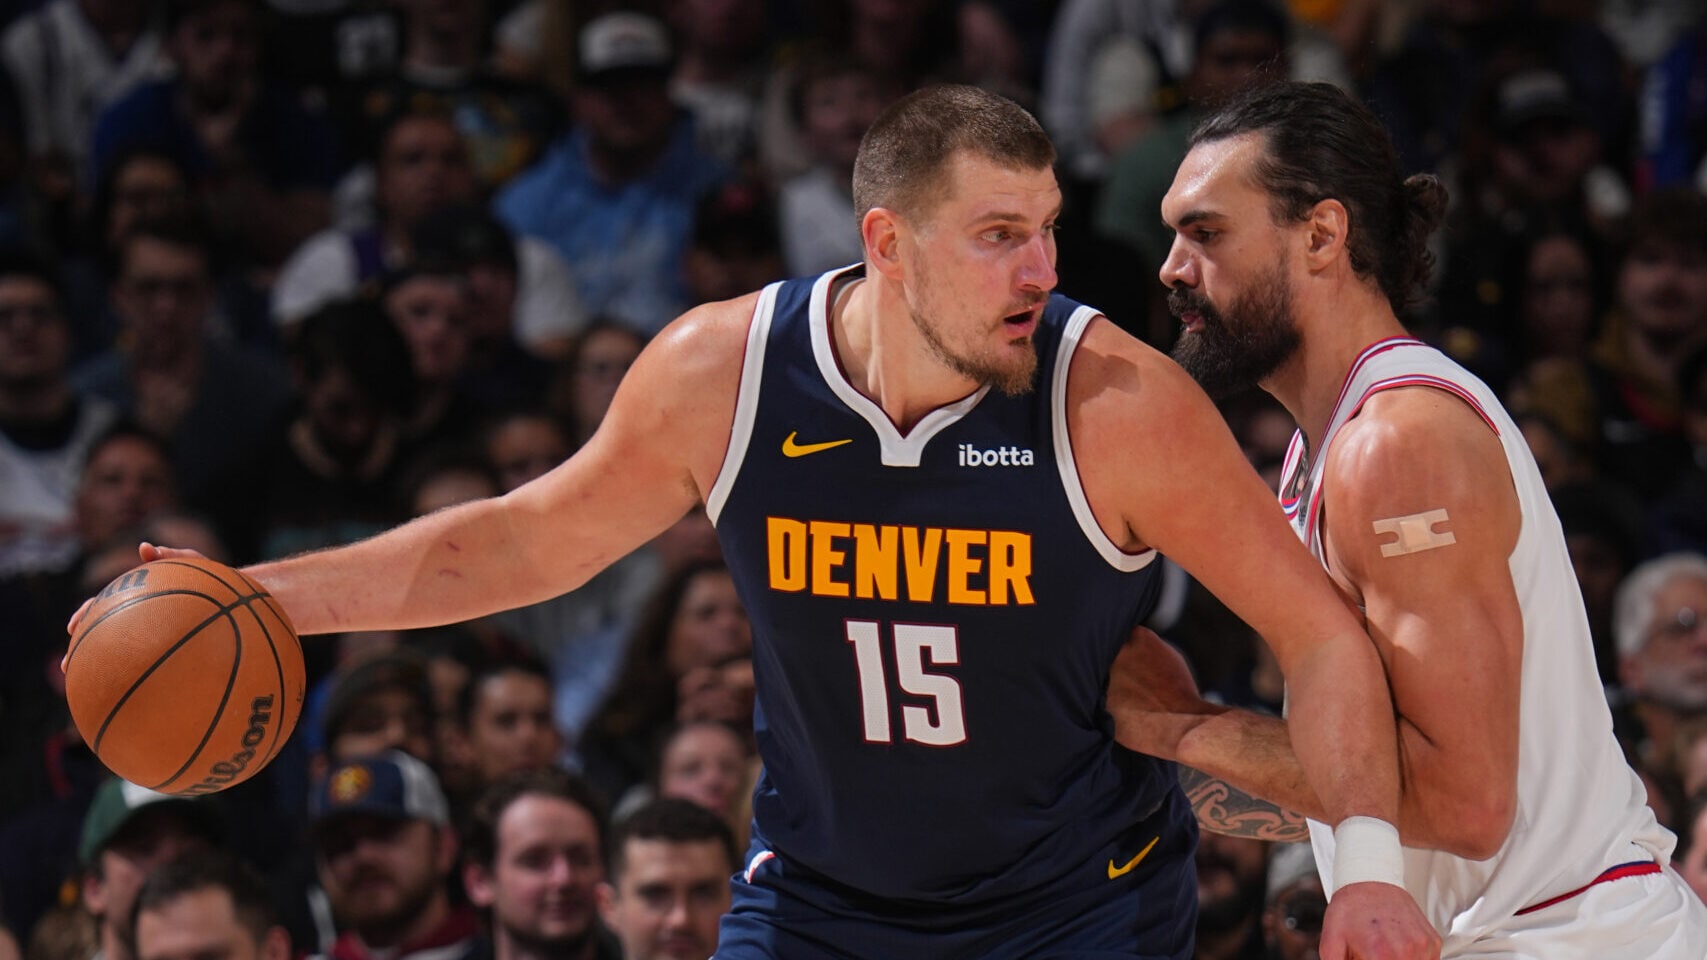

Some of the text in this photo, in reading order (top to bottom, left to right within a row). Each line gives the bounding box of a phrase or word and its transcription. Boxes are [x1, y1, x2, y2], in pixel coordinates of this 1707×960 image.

[958, 444, 1035, 467] ibotta
[766, 516, 1037, 606] DENVER
[844, 617, 969, 746] 15
